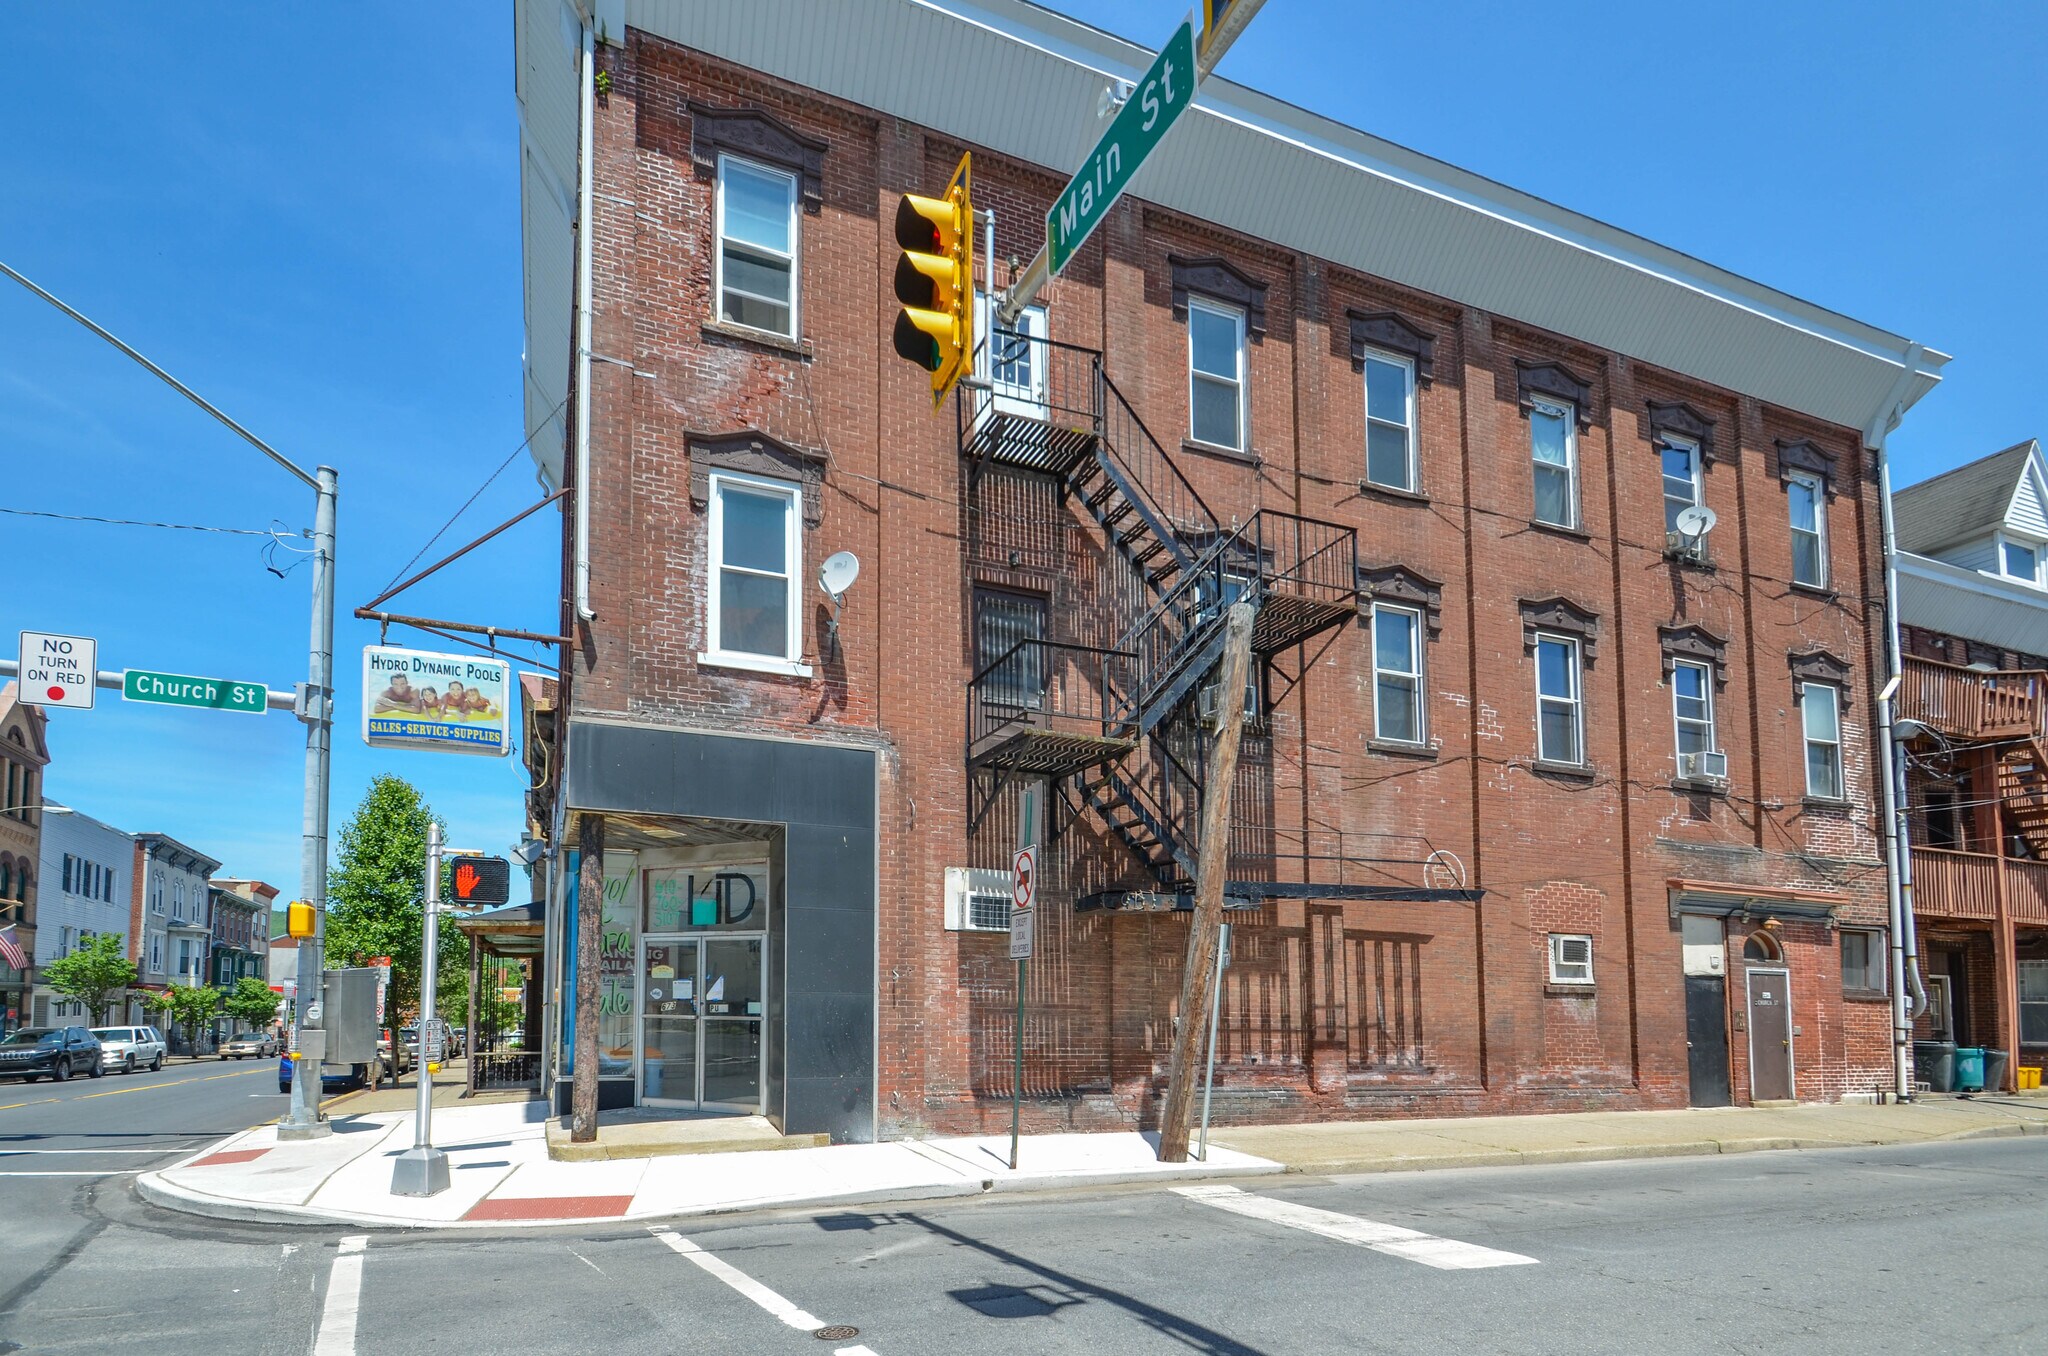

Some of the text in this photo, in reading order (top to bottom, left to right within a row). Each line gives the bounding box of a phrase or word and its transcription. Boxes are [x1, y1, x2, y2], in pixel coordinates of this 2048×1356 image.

[1060, 58, 1175, 246] Main St
[43, 639, 73, 655] NO
[38, 655, 78, 670] TURN
[371, 655, 501, 683] HYDRO DYNAMIC POOLS
[28, 669, 86, 685] ON RED
[136, 675, 256, 705] Church St
